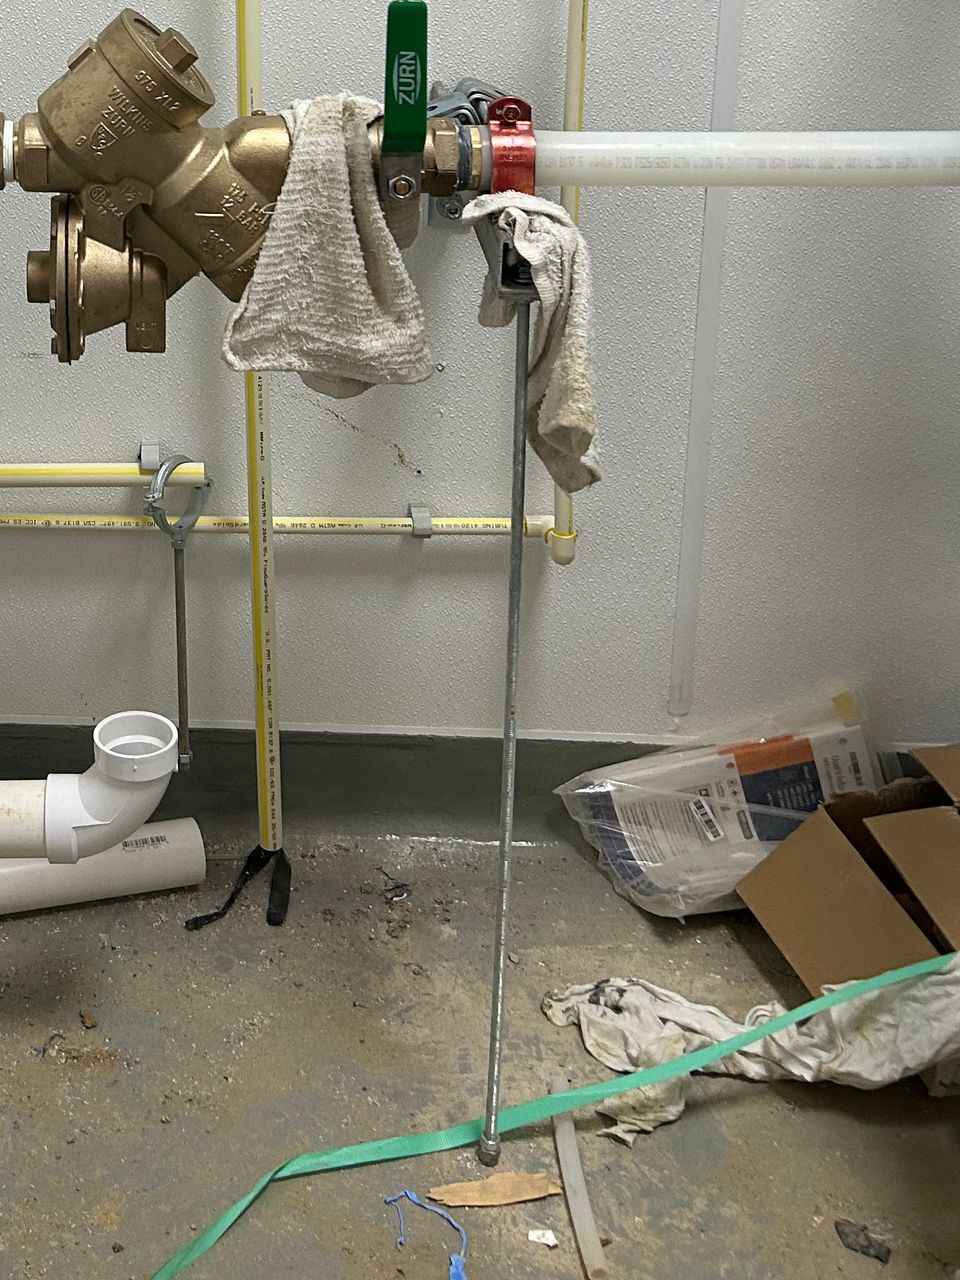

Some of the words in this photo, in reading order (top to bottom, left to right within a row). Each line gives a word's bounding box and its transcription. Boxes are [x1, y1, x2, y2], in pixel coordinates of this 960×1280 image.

[134, 69, 157, 93] 975
[398, 51, 416, 105] ZURN
[102, 105, 136, 138] ZURN
[108, 85, 154, 132] WILKINS
[220, 194, 234, 208] 12
[235, 209, 258, 234] BAR
